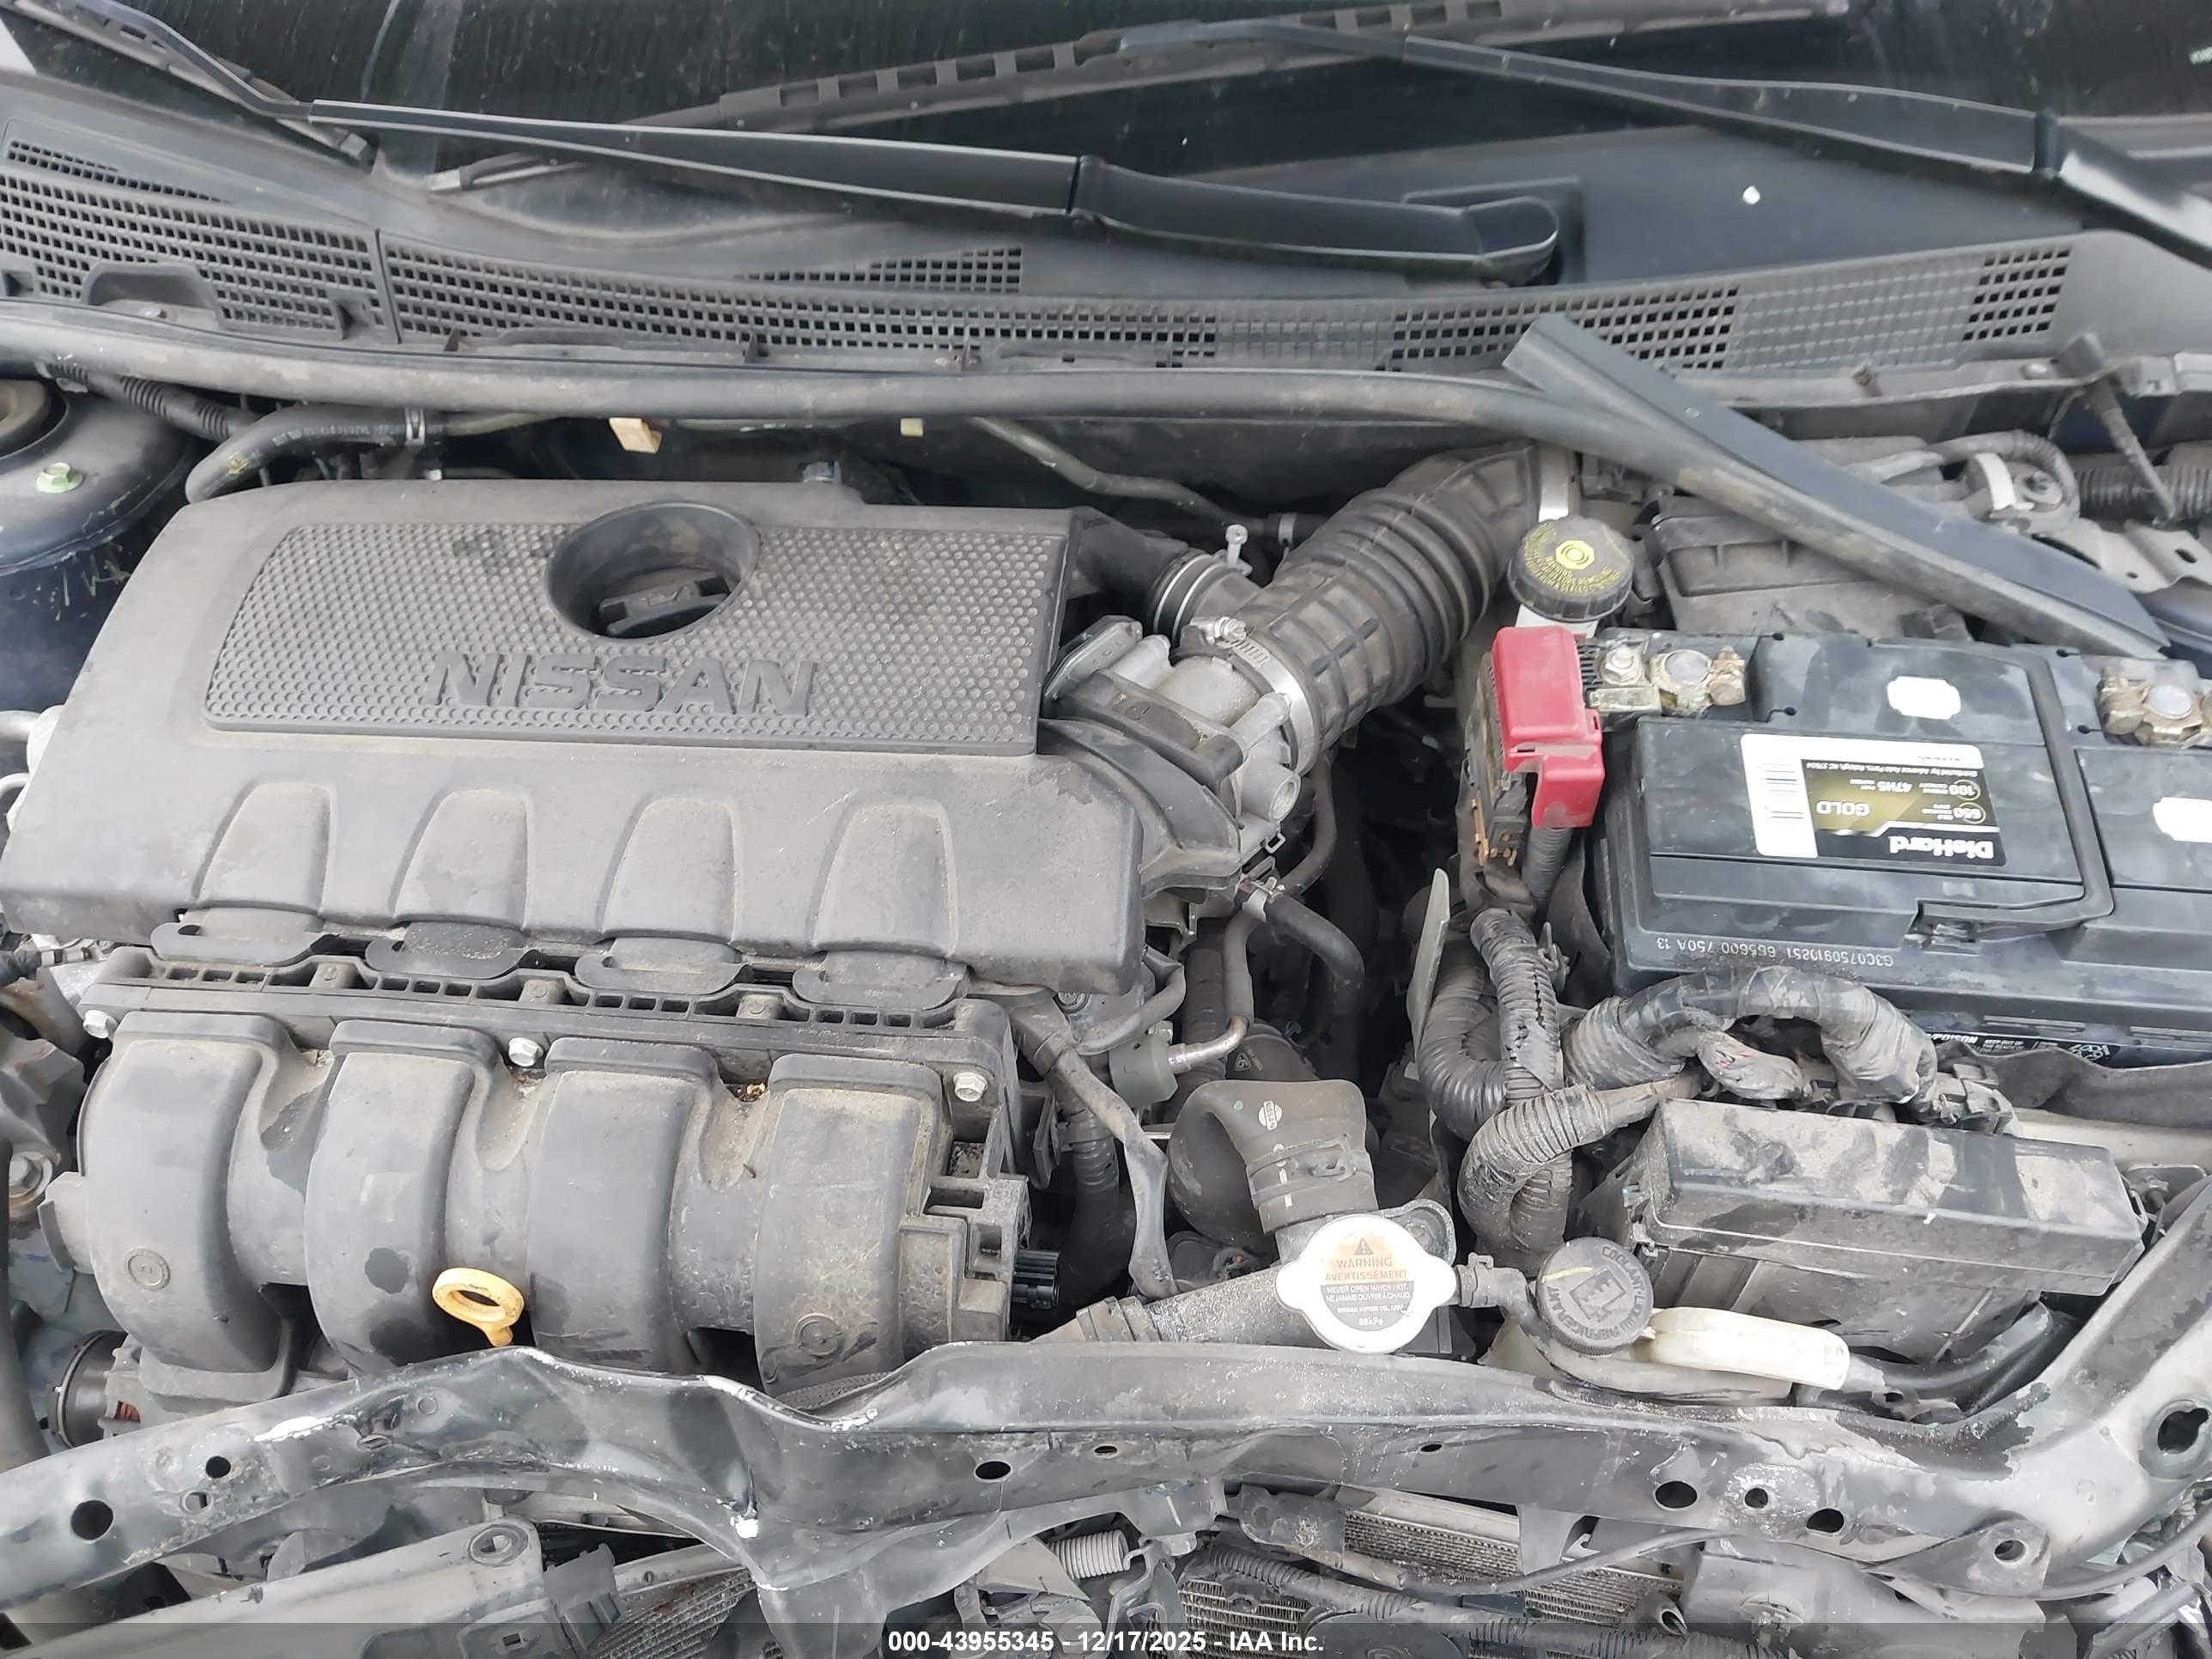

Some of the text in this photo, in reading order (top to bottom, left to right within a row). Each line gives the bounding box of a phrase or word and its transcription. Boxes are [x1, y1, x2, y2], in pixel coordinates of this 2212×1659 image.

[428, 652, 817, 716] NISSAN
[1949, 785, 1975, 796] 100
[1817, 800, 1869, 817] GOLD
[1954, 807, 1982, 819] 650
[1887, 835, 1995, 860] DieHard
[1676, 938, 1714, 954] 750A
[1336, 1257, 1393, 1269] WARNING
[1326, 1269, 1407, 1281] AVERTISSEMENT
[1327, 1285, 1349, 1294] NEVER
[1350, 1285, 1369, 1293] OPEN
[1370, 1284, 1392, 1292] WHEN
[1338, 1305, 1358, 1314] NISSAN
